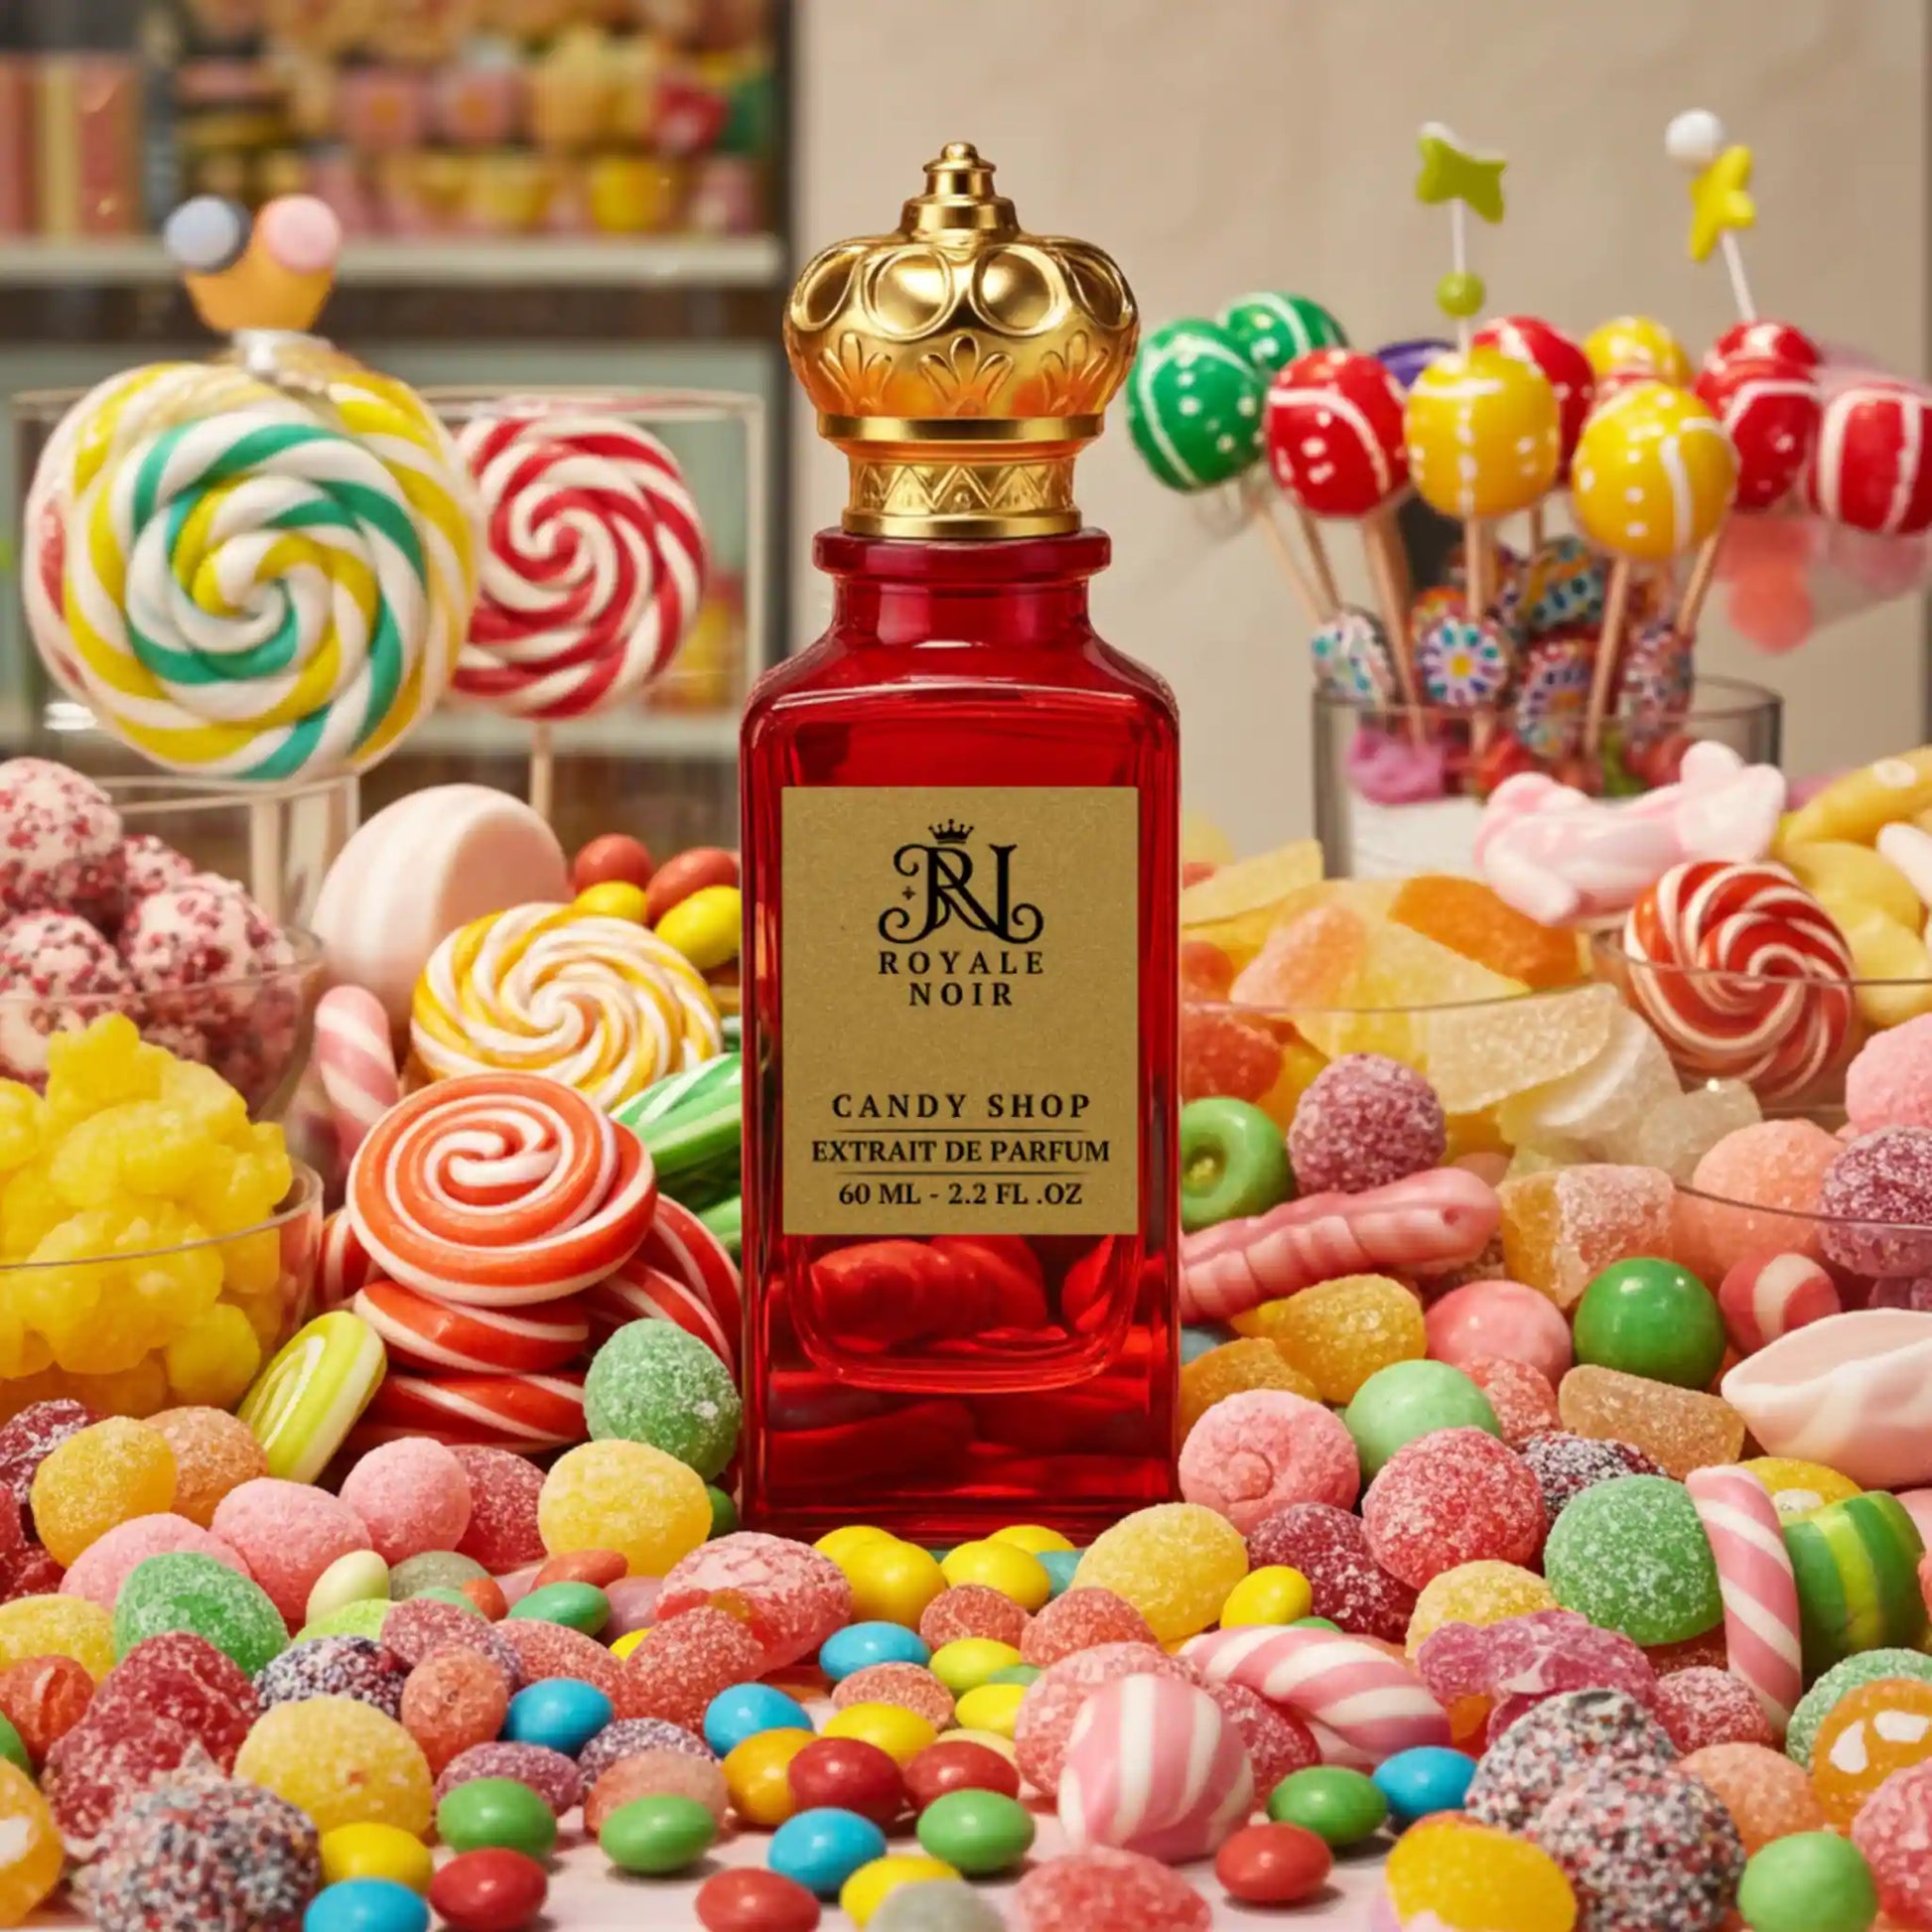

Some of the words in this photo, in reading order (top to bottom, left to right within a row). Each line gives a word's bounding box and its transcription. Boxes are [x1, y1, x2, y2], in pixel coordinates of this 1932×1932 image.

[878, 950, 1043, 975] ROYALE
[908, 982, 1013, 1007] NOIR
[831, 1093, 967, 1119] CANDY
[987, 1093, 1090, 1119] SHOP
[811, 1140, 937, 1164] EXTRAIT
[944, 1140, 983, 1164] DE
[990, 1140, 1110, 1164] PARFUM
[838, 1182, 872, 1205] 60
[878, 1182, 922, 1205] ML
[947, 1182, 987, 1205] 2.2
